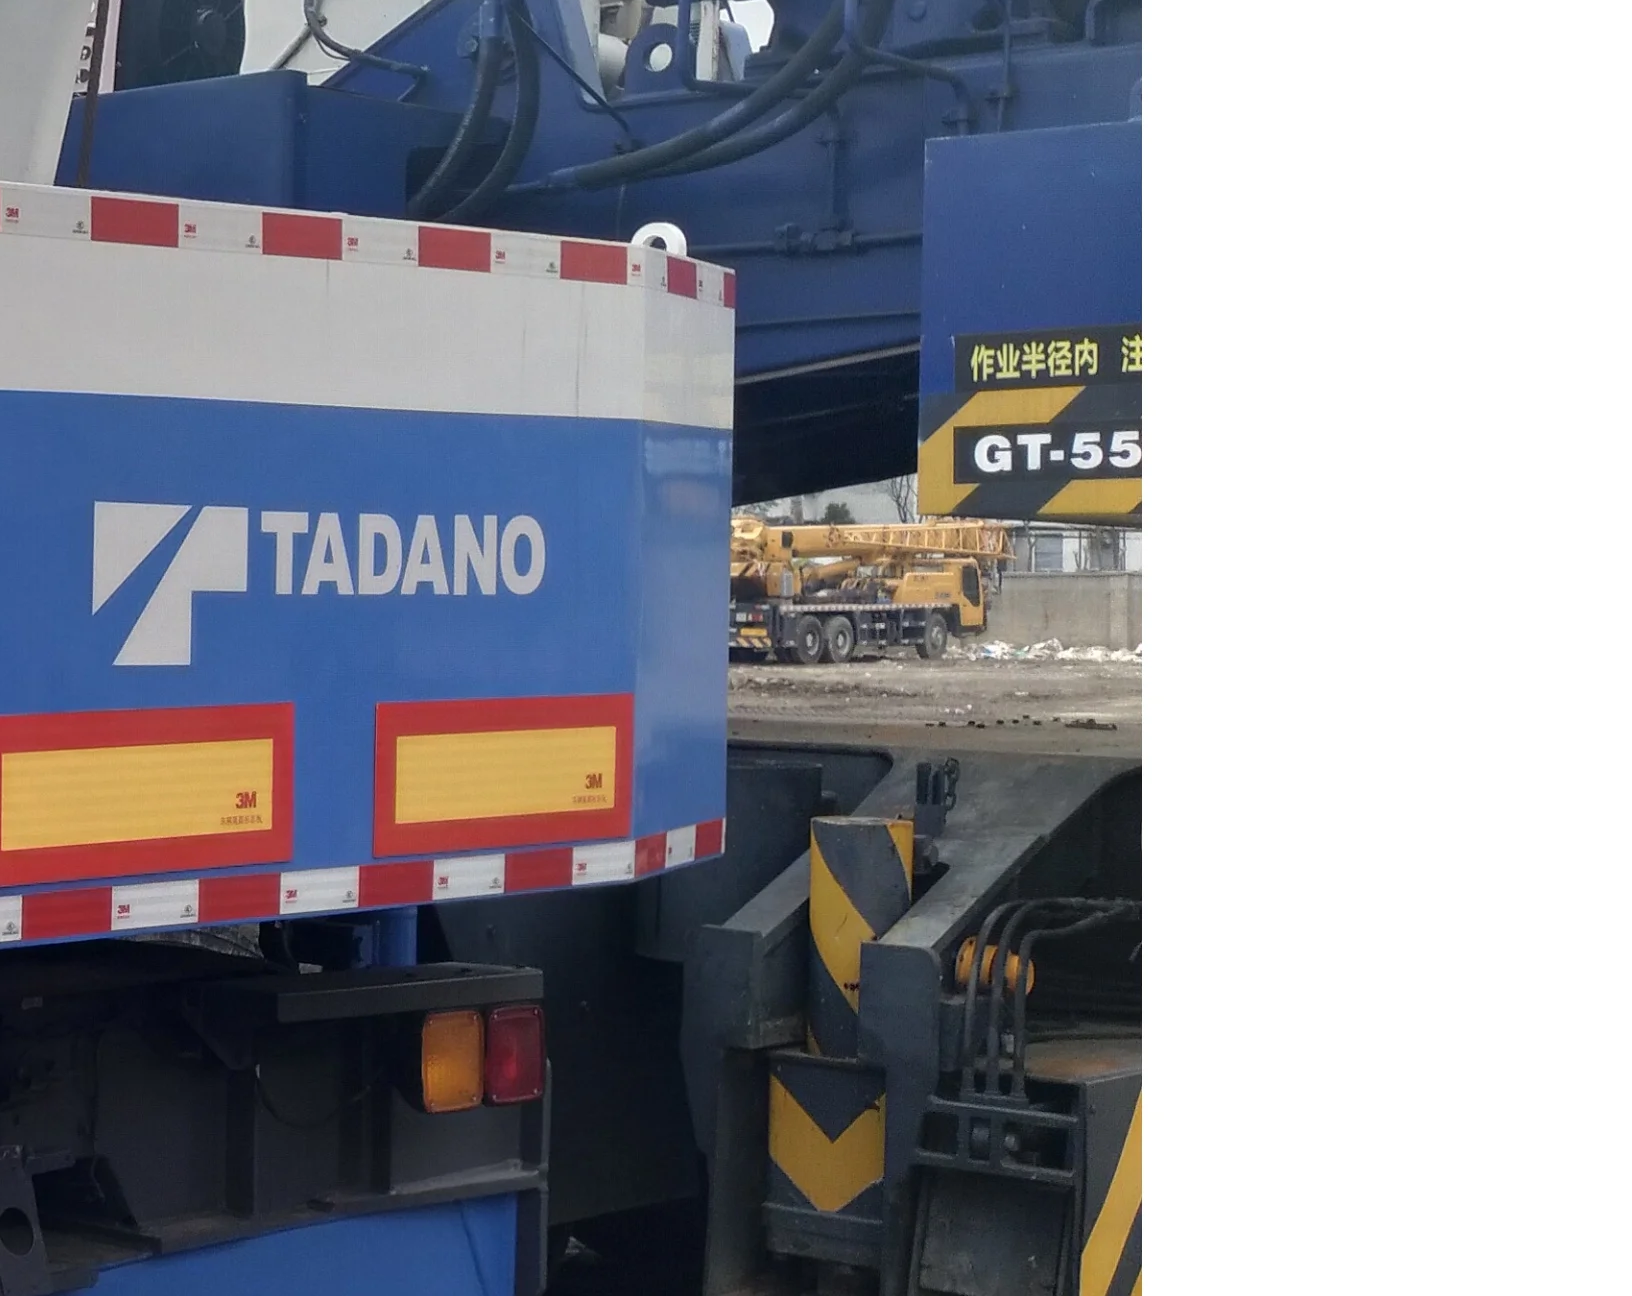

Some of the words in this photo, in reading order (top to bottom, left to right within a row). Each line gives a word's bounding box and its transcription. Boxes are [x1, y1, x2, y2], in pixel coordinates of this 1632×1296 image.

[6, 207, 19, 218] 3M
[971, 337, 1098, 382] 作业半径内
[261, 511, 546, 595] TADANO
[585, 773, 603, 789] 3M
[235, 791, 257, 809] 3M
